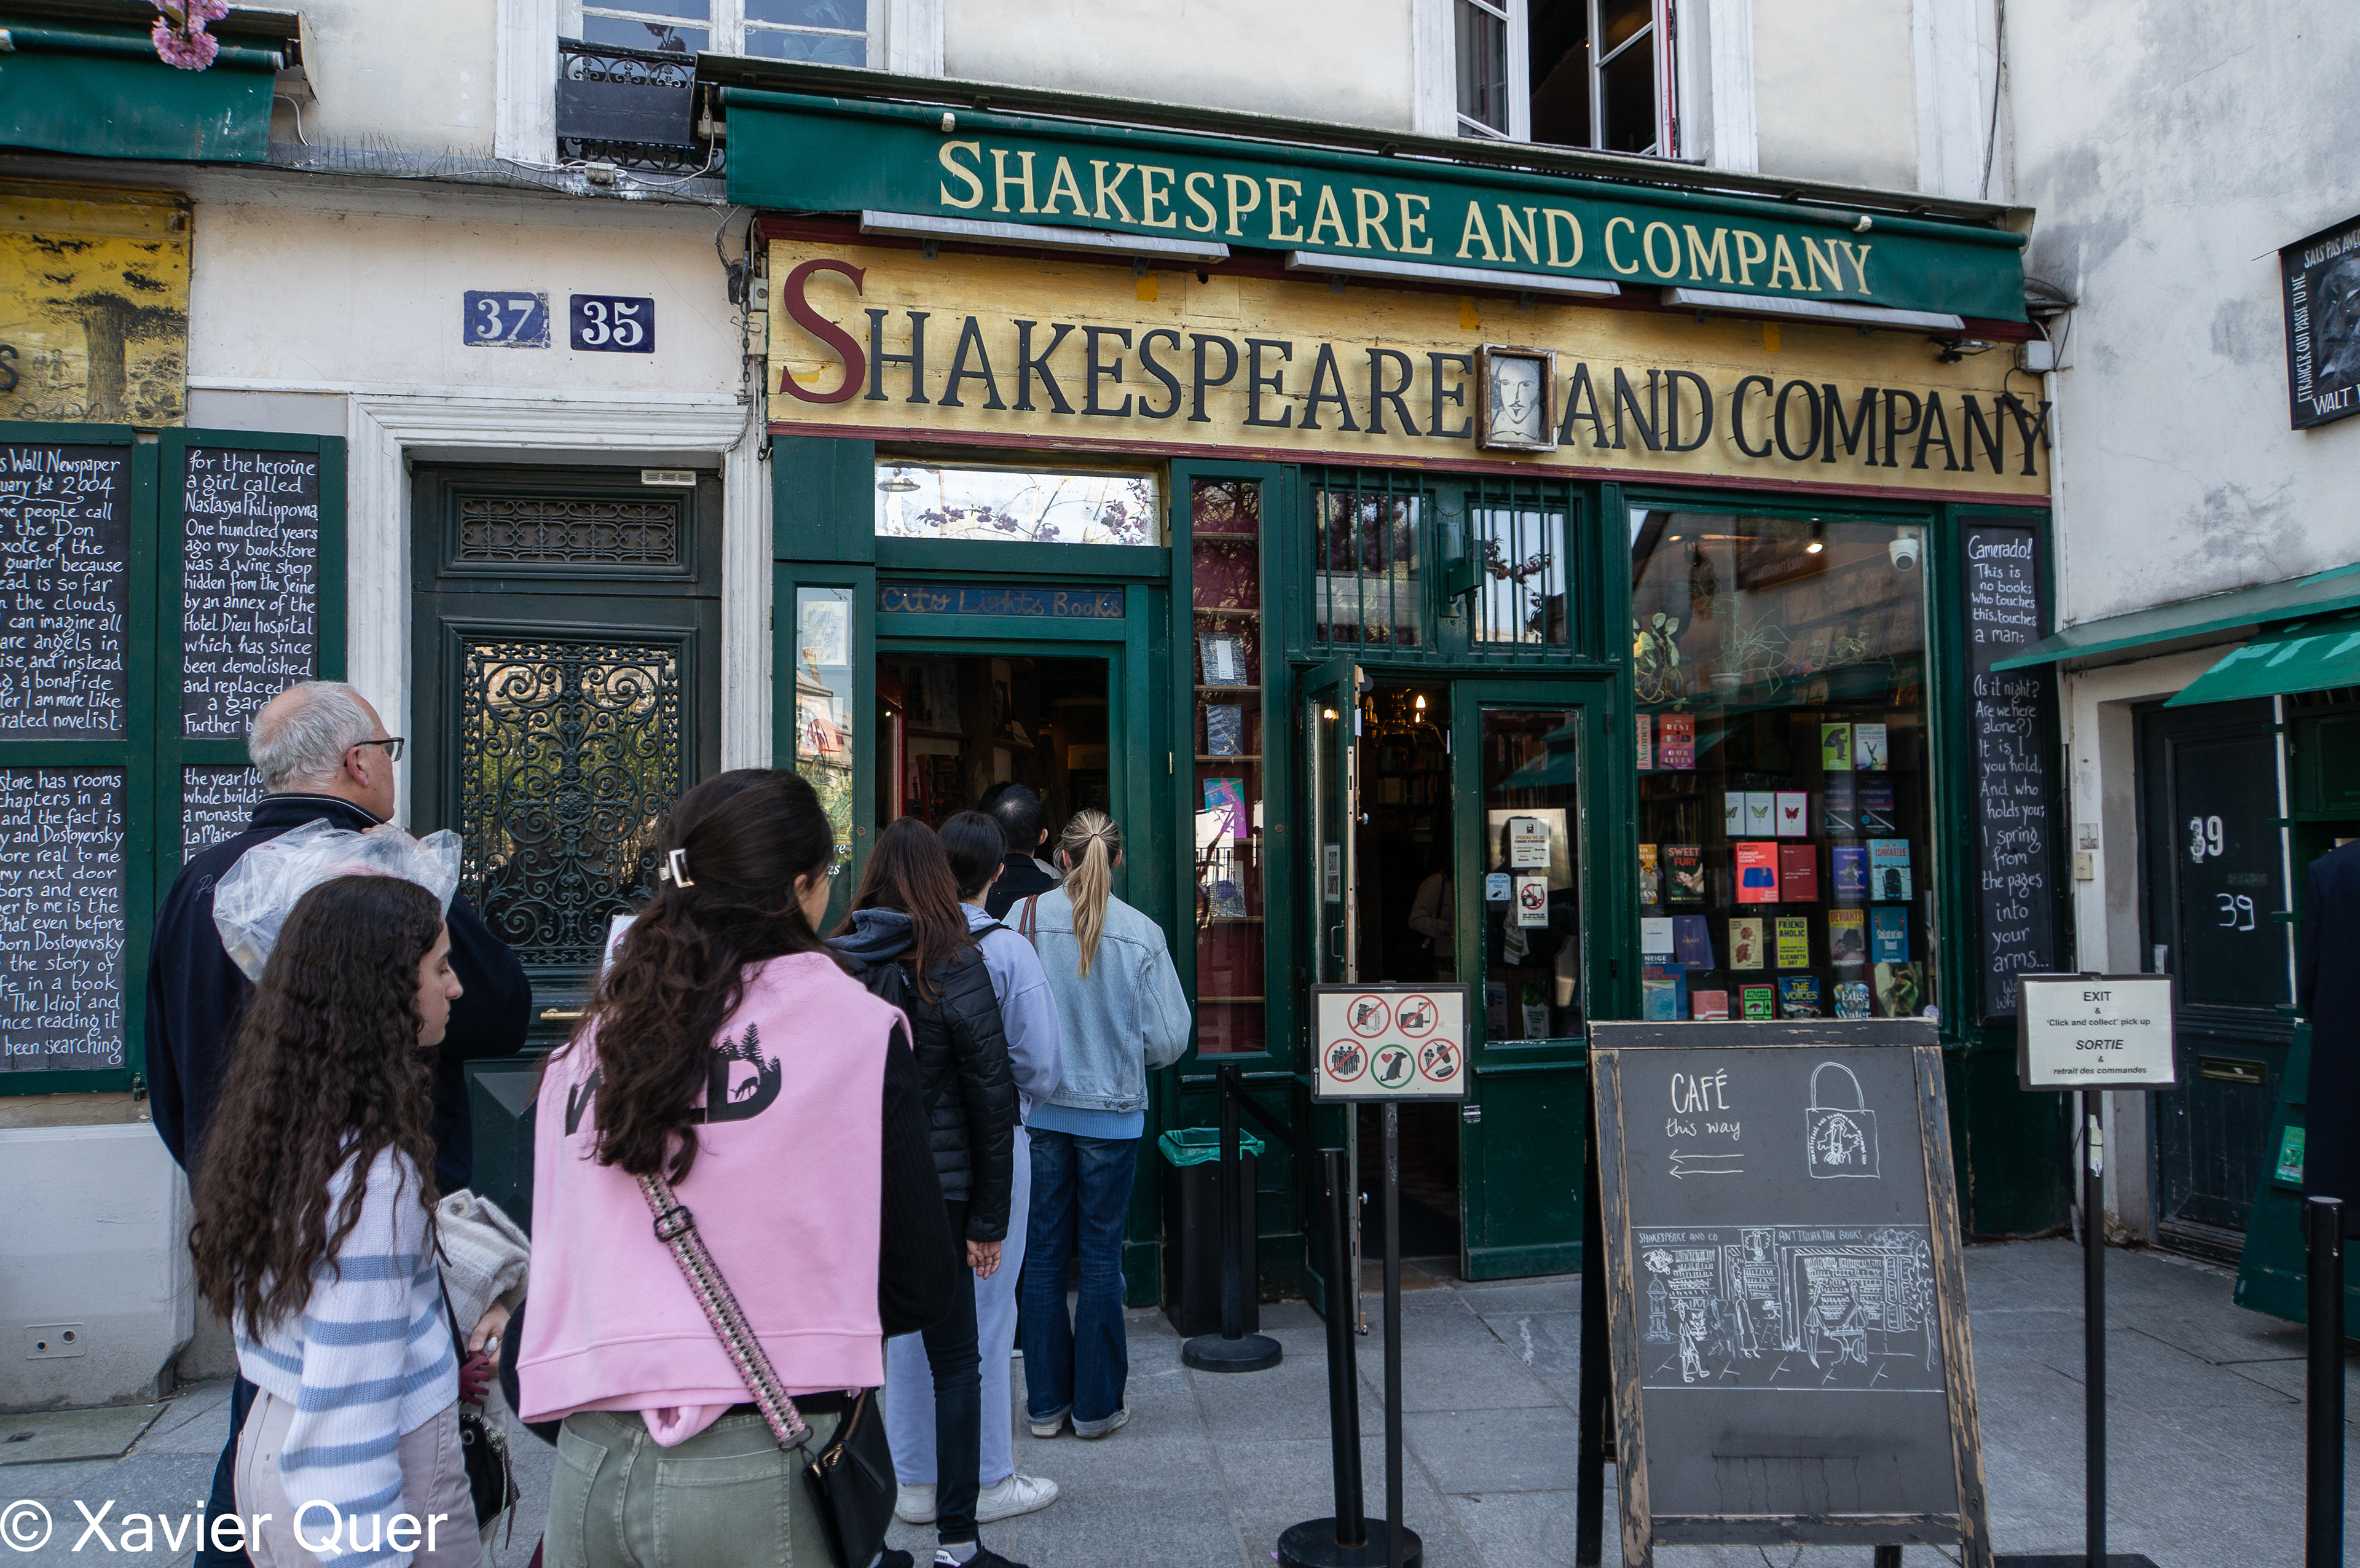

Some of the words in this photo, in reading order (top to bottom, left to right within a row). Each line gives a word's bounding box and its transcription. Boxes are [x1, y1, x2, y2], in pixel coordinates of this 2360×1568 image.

[938, 140, 1432, 255] SHAKESPEARE
[1455, 200, 1583, 268] AND
[1604, 216, 1872, 296] COMPANY
[2304, 250, 2324, 269] SAIS
[2326, 238, 2340, 257] PAS
[2292, 272, 2306, 289] NE
[2293, 291, 2306, 306] TU
[476, 299, 535, 340] 37
[582, 301, 643, 347] 35
[2295, 304, 2309, 332] PASSE
[2296, 329, 2310, 354] QUI
[778, 257, 1473, 440] SHAKESPEARE
[1559, 362, 1714, 452] AND
[1731, 374, 2052, 476] COMPANY
[2313, 386, 2352, 415] WALT
[9, 449, 42, 472] Wall
[46, 449, 120, 482] Newspaper
[189, 450, 216, 472] for
[222, 453, 252, 472] the
[256, 454, 315, 476] heroine
[34, 476, 53, 493] 1st
[61, 476, 116, 499] 2004
[187, 475, 197, 488] a
[203, 476, 239, 496] girl
[244, 476, 303, 493] called
[185, 492, 241, 520] Nastasya
[186, 519, 215, 536] One
[219, 517, 280, 538] hundred
[281, 528, 318, 548] years
[185, 539, 211, 559] ago
[217, 542, 240, 562] my
[246, 539, 316, 557] bookstore
[1968, 535, 2032, 562] Camerado!
[185, 559, 213, 571] was
[219, 557, 232, 571] a
[237, 558, 272, 572] wine
[275, 559, 312, 585] shop
[1973, 563, 2003, 579] This
[2010, 565, 2020, 578] is
[185, 573, 225, 590] hidden
[230, 571, 256, 596] from
[260, 573, 279, 591] the
[281, 574, 315, 594] Seine
[1980, 582, 1994, 590] no
[1998, 580, 2031, 594] book;
[184, 594, 201, 616] by
[203, 597, 220, 609] an
[224, 596, 266, 610] annex
[269, 594, 287, 616] of
[291, 597, 315, 613] the
[881, 586, 950, 613] City
[958, 589, 1045, 615] Lights
[1972, 592, 1993, 605] Who
[1996, 593, 2035, 609] touches
[184, 612, 219, 632] Hotel
[221, 613, 250, 632] Dieu
[255, 613, 313, 638] hospital
[1997, 610, 2036, 626] touches
[185, 633, 232, 653] which
[238, 635, 264, 654] has
[270, 639, 312, 654] since
[1974, 629, 1987, 643] a
[1991, 629, 2024, 643] man;
[1974, 674, 1987, 697] (Is
[1991, 676, 2000, 696] it
[2004, 679, 2039, 705] night?
[1975, 700, 1994, 719] Are
[1997, 707, 2010, 716] we
[2012, 702, 2036, 717] here
[1982, 716, 2032, 737] alone?)
[1978, 738, 1991, 758] It
[2018, 736, 2024, 756] I
[1983, 763, 2006, 779] you
[2008, 754, 2042, 774] hold,
[1980, 778, 2008, 797] And
[2015, 777, 2038, 795] who
[1987, 798, 2019, 819] holds
[1982, 825, 1989, 847] I
[1997, 826, 2041, 853] spring
[2190, 816, 2223, 857] 39
[1669, 847, 1699, 857] SWEET
[1674, 857, 1697, 866] FURY
[1992, 846, 2028, 871] from
[0, 871, 22, 885] my
[29, 866, 64, 879] next
[73, 866, 117, 879] door
[1982, 870, 2004, 890] the
[2007, 872, 2042, 898] pages
[1996, 899, 2028, 922] into
[2216, 893, 2255, 931] 39
[1991, 928, 2029, 954] your
[1993, 951, 2048, 972] arms...
[88, 992, 120, 1009] and
[1784, 991, 1818, 1000] VOICES
[1841, 990, 1870, 1003] Edge
[2084, 992, 2111, 1001] EXIT
[6, 1035, 39, 1056] been
[44, 1033, 122, 1064] searching
[2076, 1040, 2123, 1049] SORTIE
[1672, 1068, 1730, 1113] CAFÉ
[1666, 1118, 1697, 1137] this
[1709, 1121, 1741, 1141] way
[1639, 1233, 1686, 1243] SHAKESPEARE
[1690, 1233, 1705, 1241] AND
[1839, 1230, 1863, 1239] BOOKS
